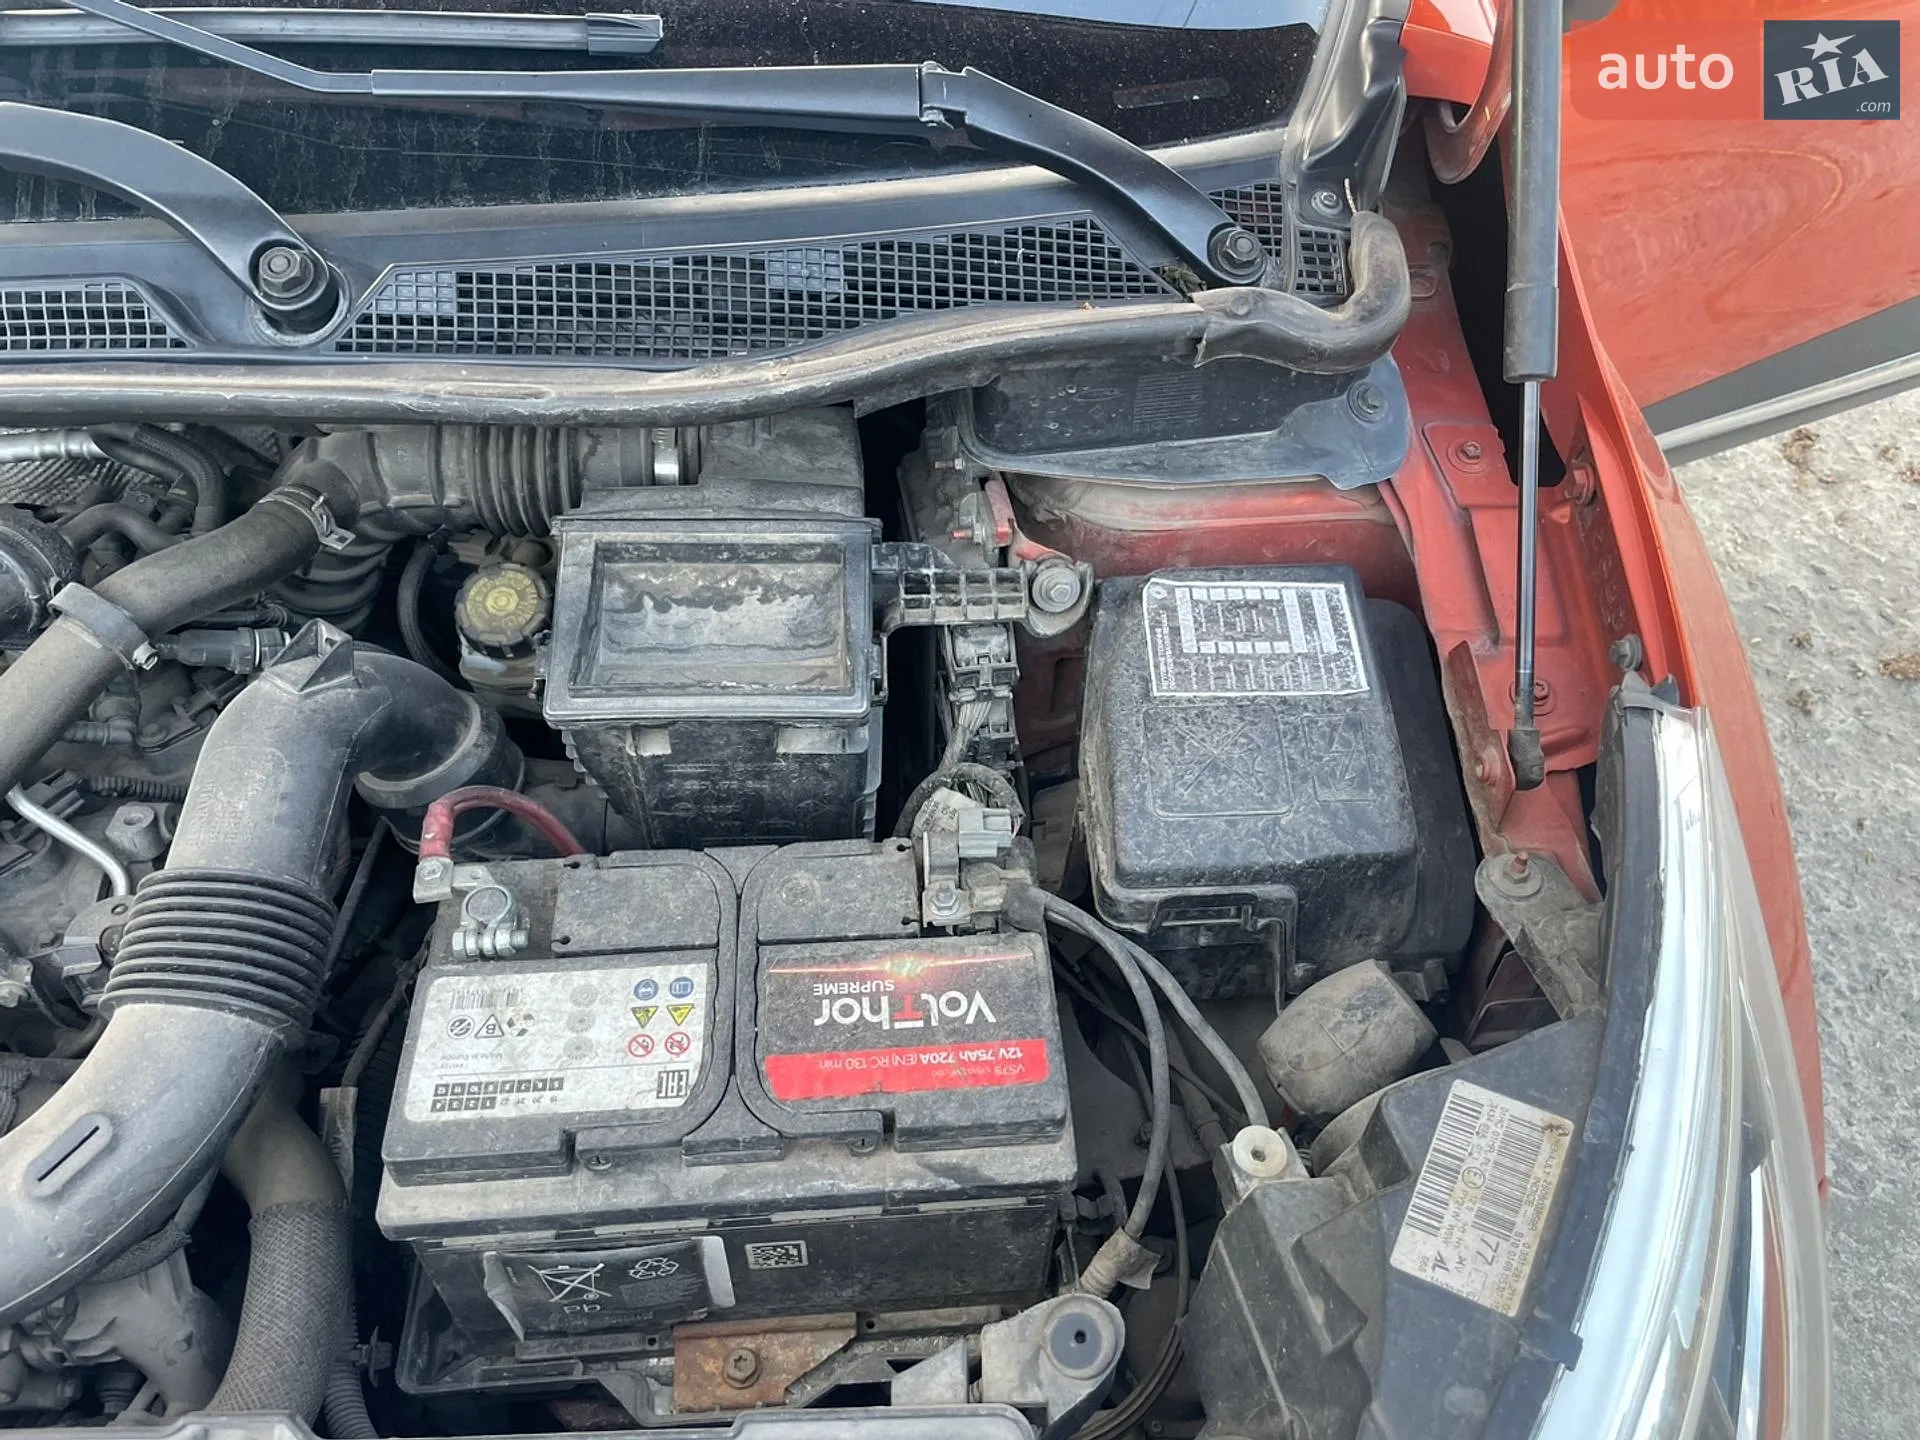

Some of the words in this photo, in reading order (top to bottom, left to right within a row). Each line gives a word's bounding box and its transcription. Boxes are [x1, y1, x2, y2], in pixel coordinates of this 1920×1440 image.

[814, 979, 895, 994] SUPREME
[814, 990, 996, 1030] VolThor
[891, 1053, 917, 1066] (EN)
[920, 1052, 954, 1064] 720A
[959, 1049, 996, 1062] 75Ah
[998, 1047, 1023, 1060] 12V
[819, 1059, 843, 1071] min
[846, 1057, 867, 1070] 130
[871, 1056, 889, 1068] RC
[995, 1064, 1024, 1075] VS75
[656, 1069, 690, 1099] EAC
[1472, 1234, 1500, 1267] 77
[562, 1302, 601, 1315] Pb
